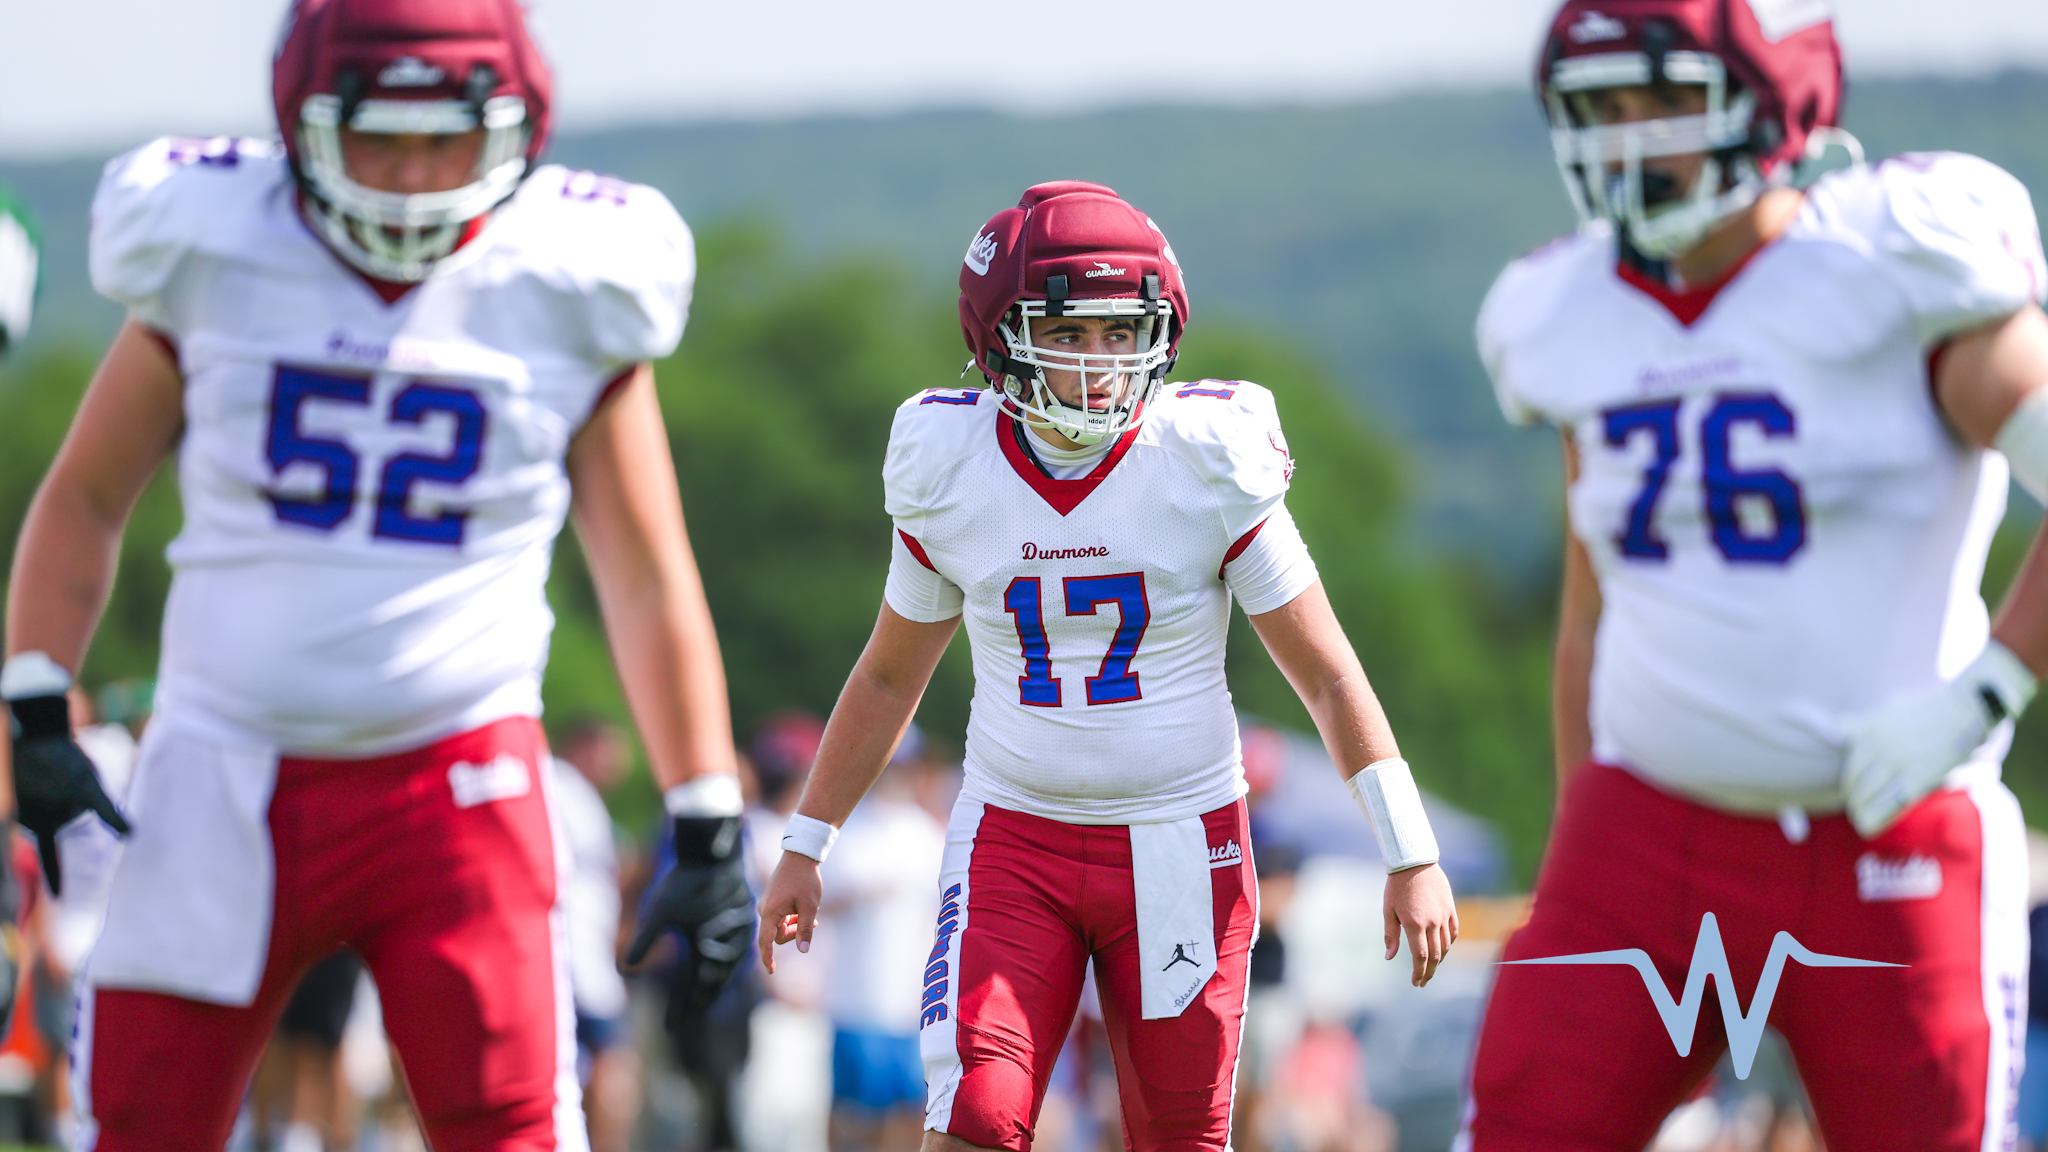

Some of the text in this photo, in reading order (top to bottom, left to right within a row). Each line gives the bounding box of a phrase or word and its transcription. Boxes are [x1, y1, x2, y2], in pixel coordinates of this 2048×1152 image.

[1085, 268, 1125, 278] GUARDIAN
[266, 362, 488, 546] 52
[1601, 389, 1808, 563] 76
[1022, 542, 1110, 560] Dunmore
[1003, 571, 1151, 708] 17
[1207, 839, 1243, 869] ucks
